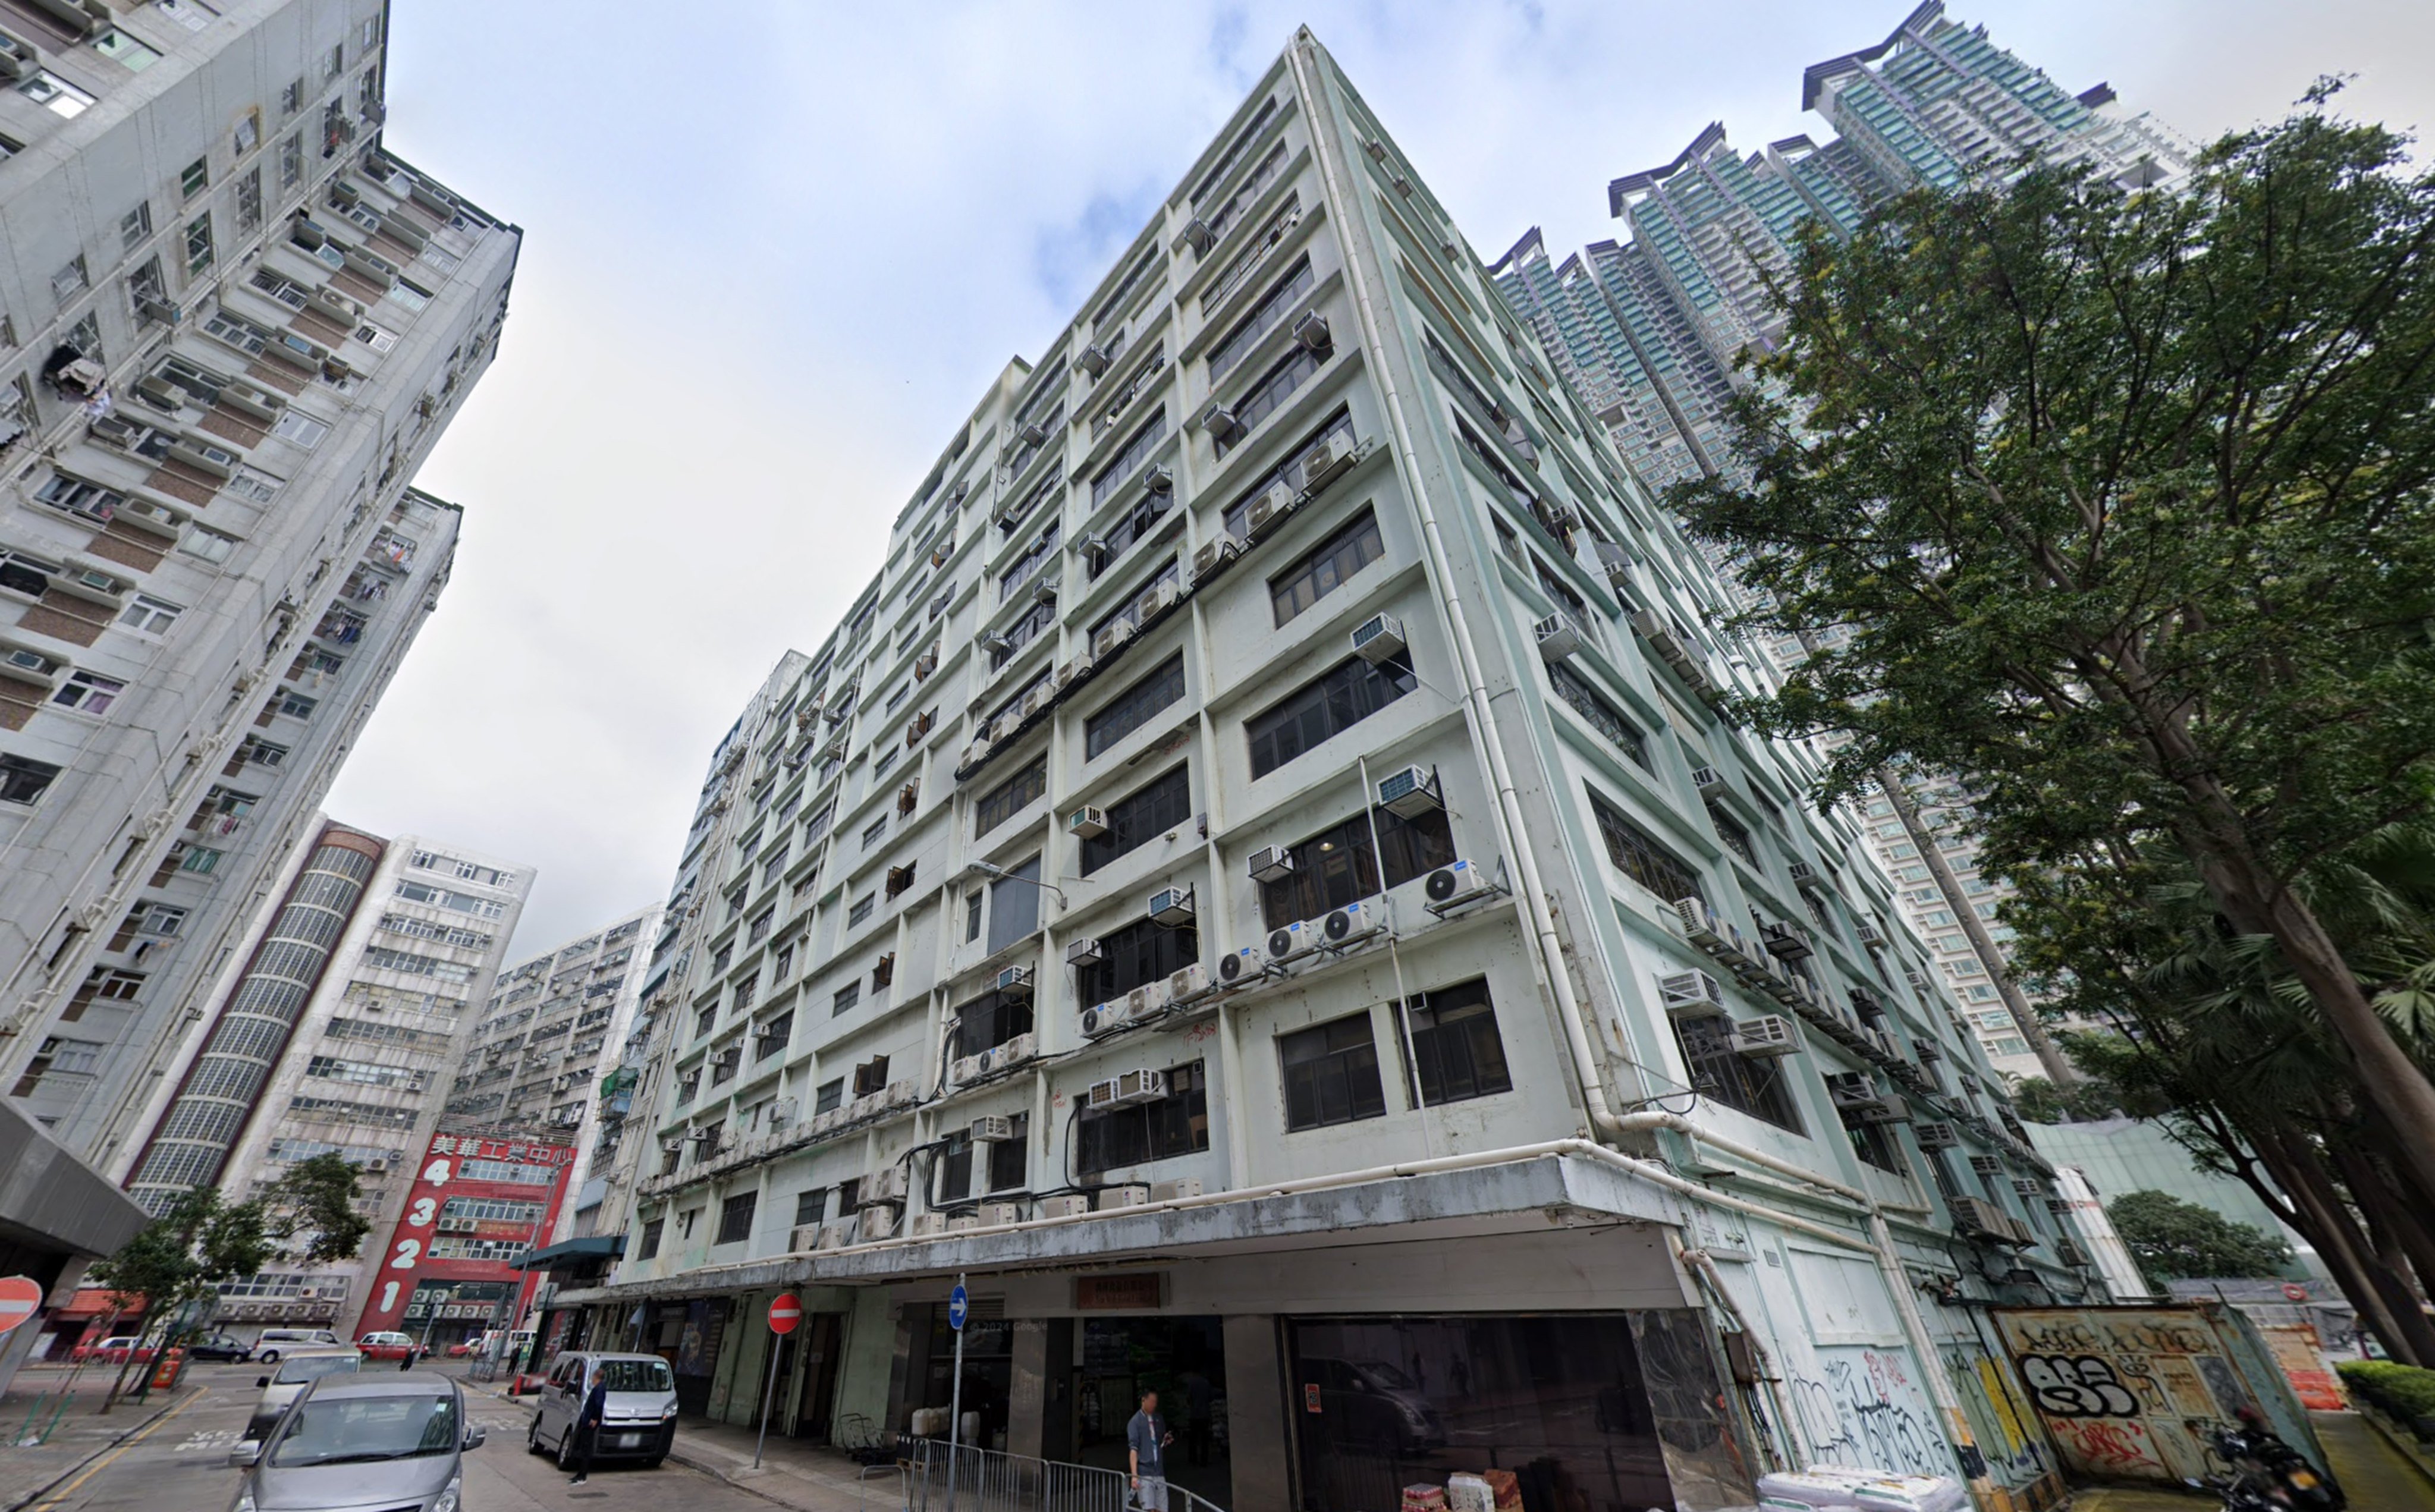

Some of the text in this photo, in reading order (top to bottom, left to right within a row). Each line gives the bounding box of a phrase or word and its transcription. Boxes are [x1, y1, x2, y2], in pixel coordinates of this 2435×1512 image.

[431, 1135, 573, 1164] 美華工業中心
[423, 1159, 451, 1186] 4
[409, 1197, 436, 1227] 3
[391, 1238, 421, 1268] 2
[380, 1281, 400, 1312] 1
